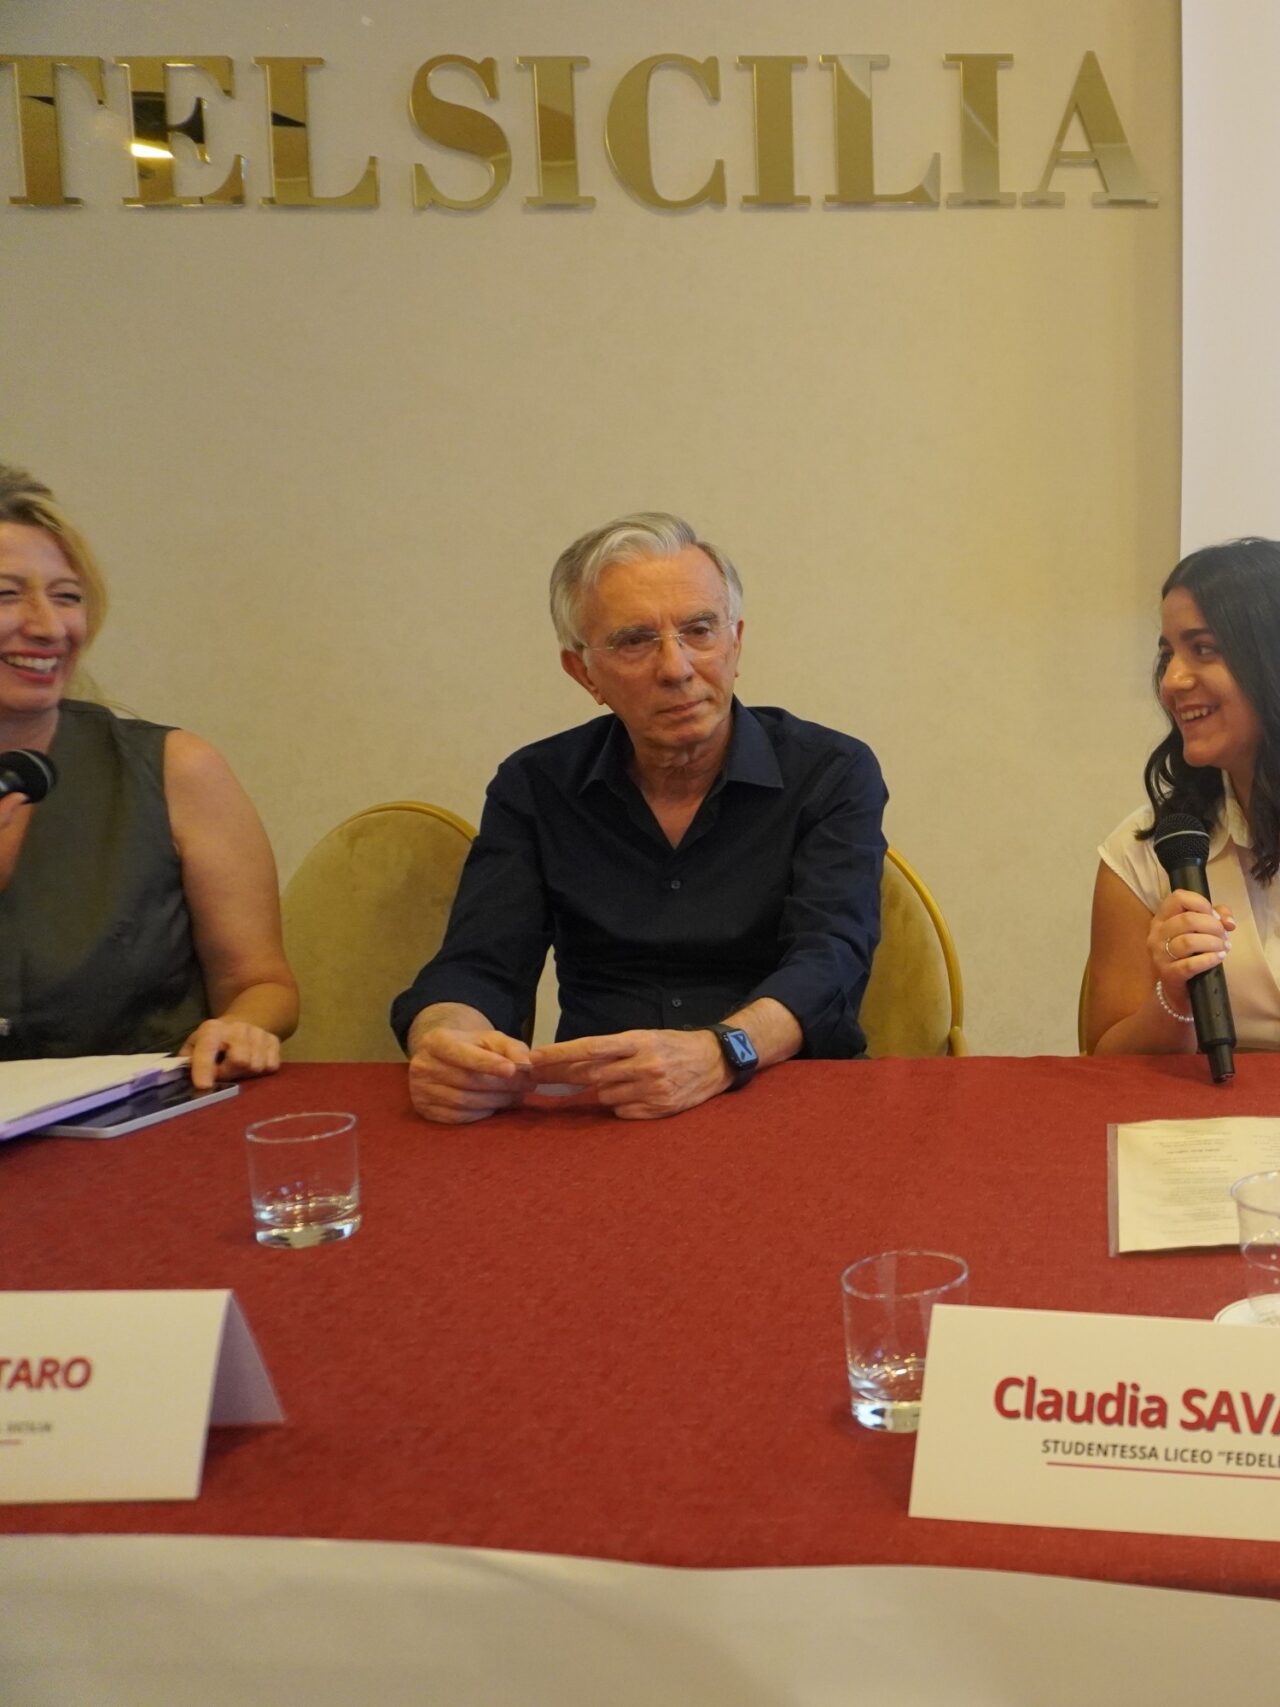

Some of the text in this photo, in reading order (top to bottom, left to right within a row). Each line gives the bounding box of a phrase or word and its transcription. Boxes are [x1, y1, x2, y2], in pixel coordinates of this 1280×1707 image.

[0, 50, 1160, 210] TEL SICILIA
[993, 1375, 1168, 1430] Claudia
[1041, 1439, 1159, 1461] STUDENTESSA
[1163, 1447, 1213, 1465] LICEO
